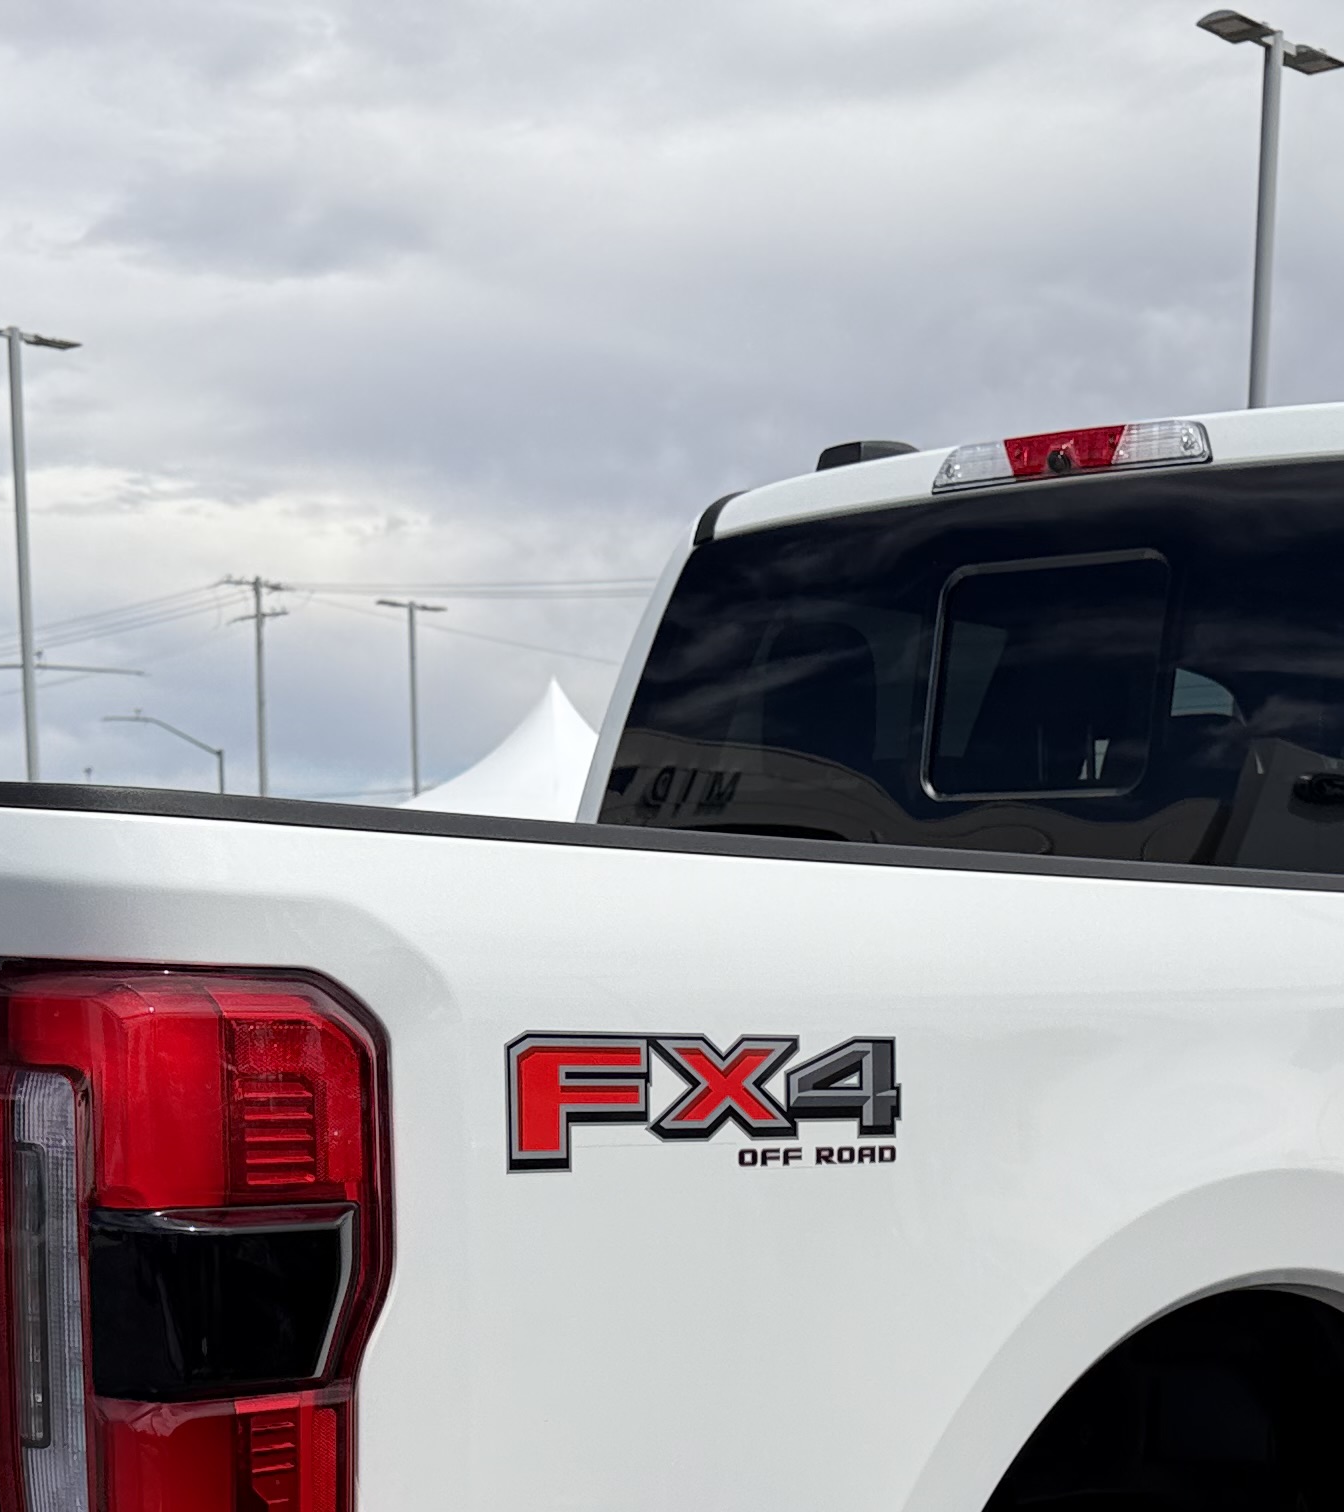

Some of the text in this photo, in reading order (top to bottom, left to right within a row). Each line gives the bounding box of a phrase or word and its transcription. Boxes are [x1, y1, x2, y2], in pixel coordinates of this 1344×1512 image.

[503, 1030, 902, 1175] FX4
[738, 1144, 896, 1167] OFF ROAD
